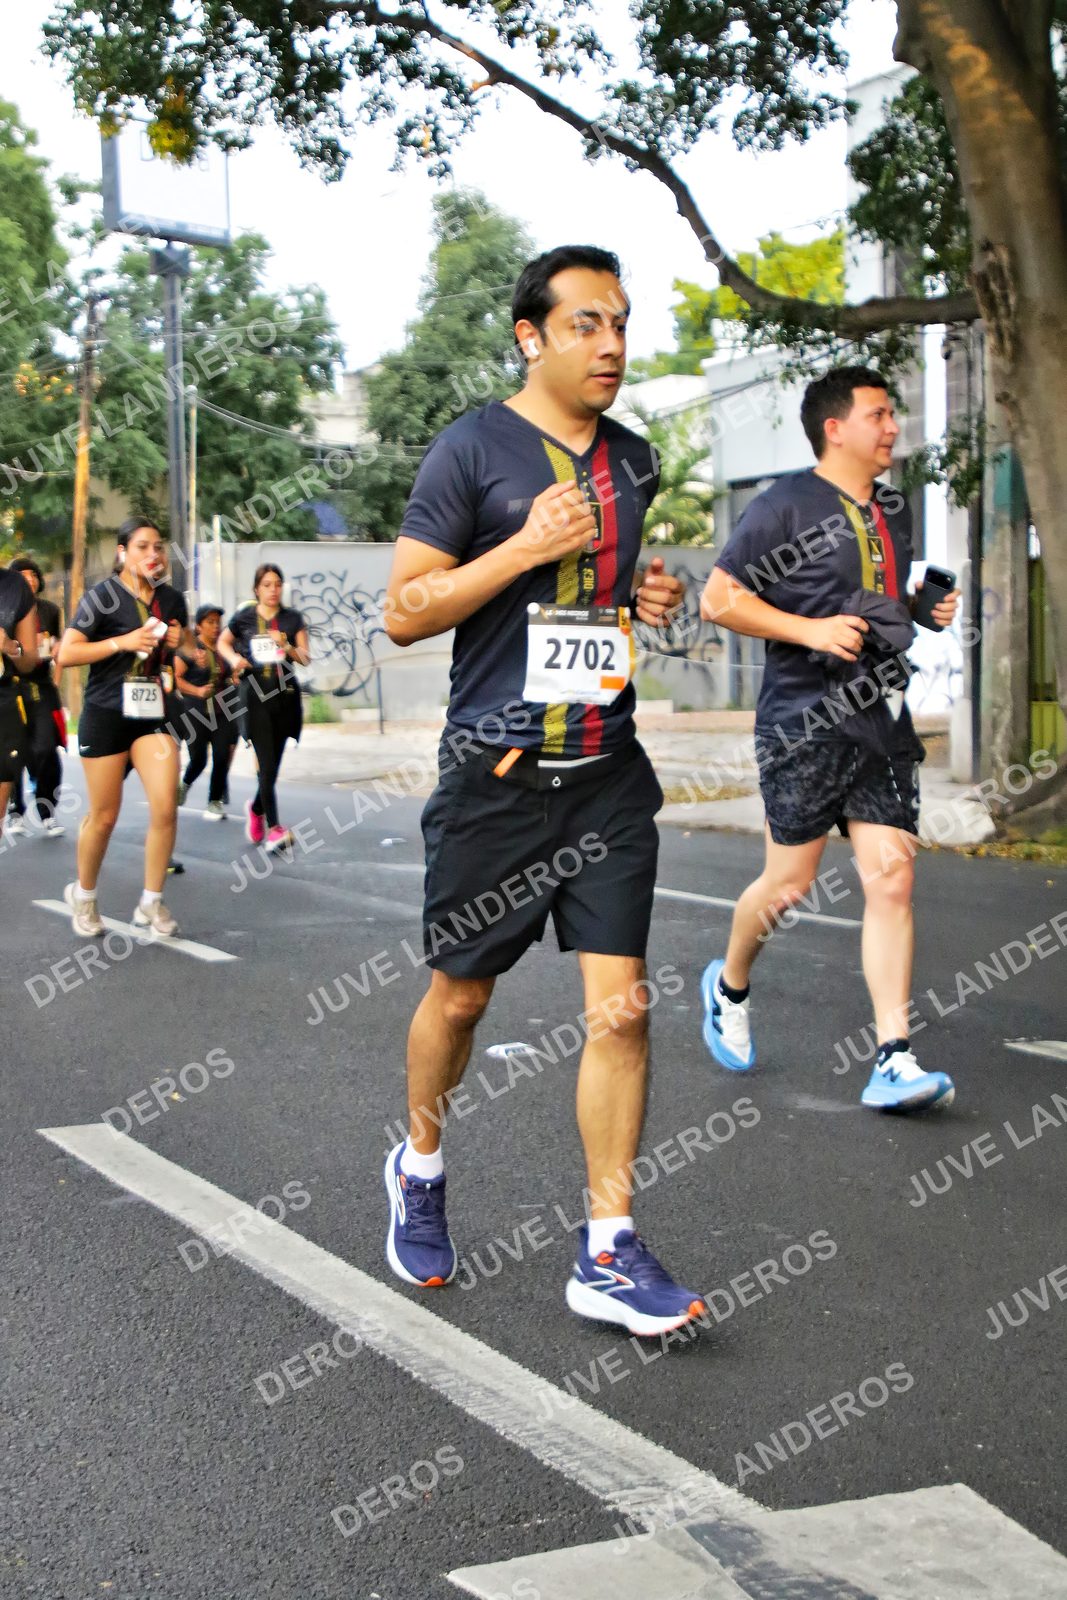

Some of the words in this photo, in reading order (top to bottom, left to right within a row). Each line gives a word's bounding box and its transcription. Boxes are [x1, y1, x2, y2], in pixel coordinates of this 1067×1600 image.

[292, 569, 348, 590] TOY
[544, 638, 615, 671] 2702
[131, 688, 157, 702] 8725
